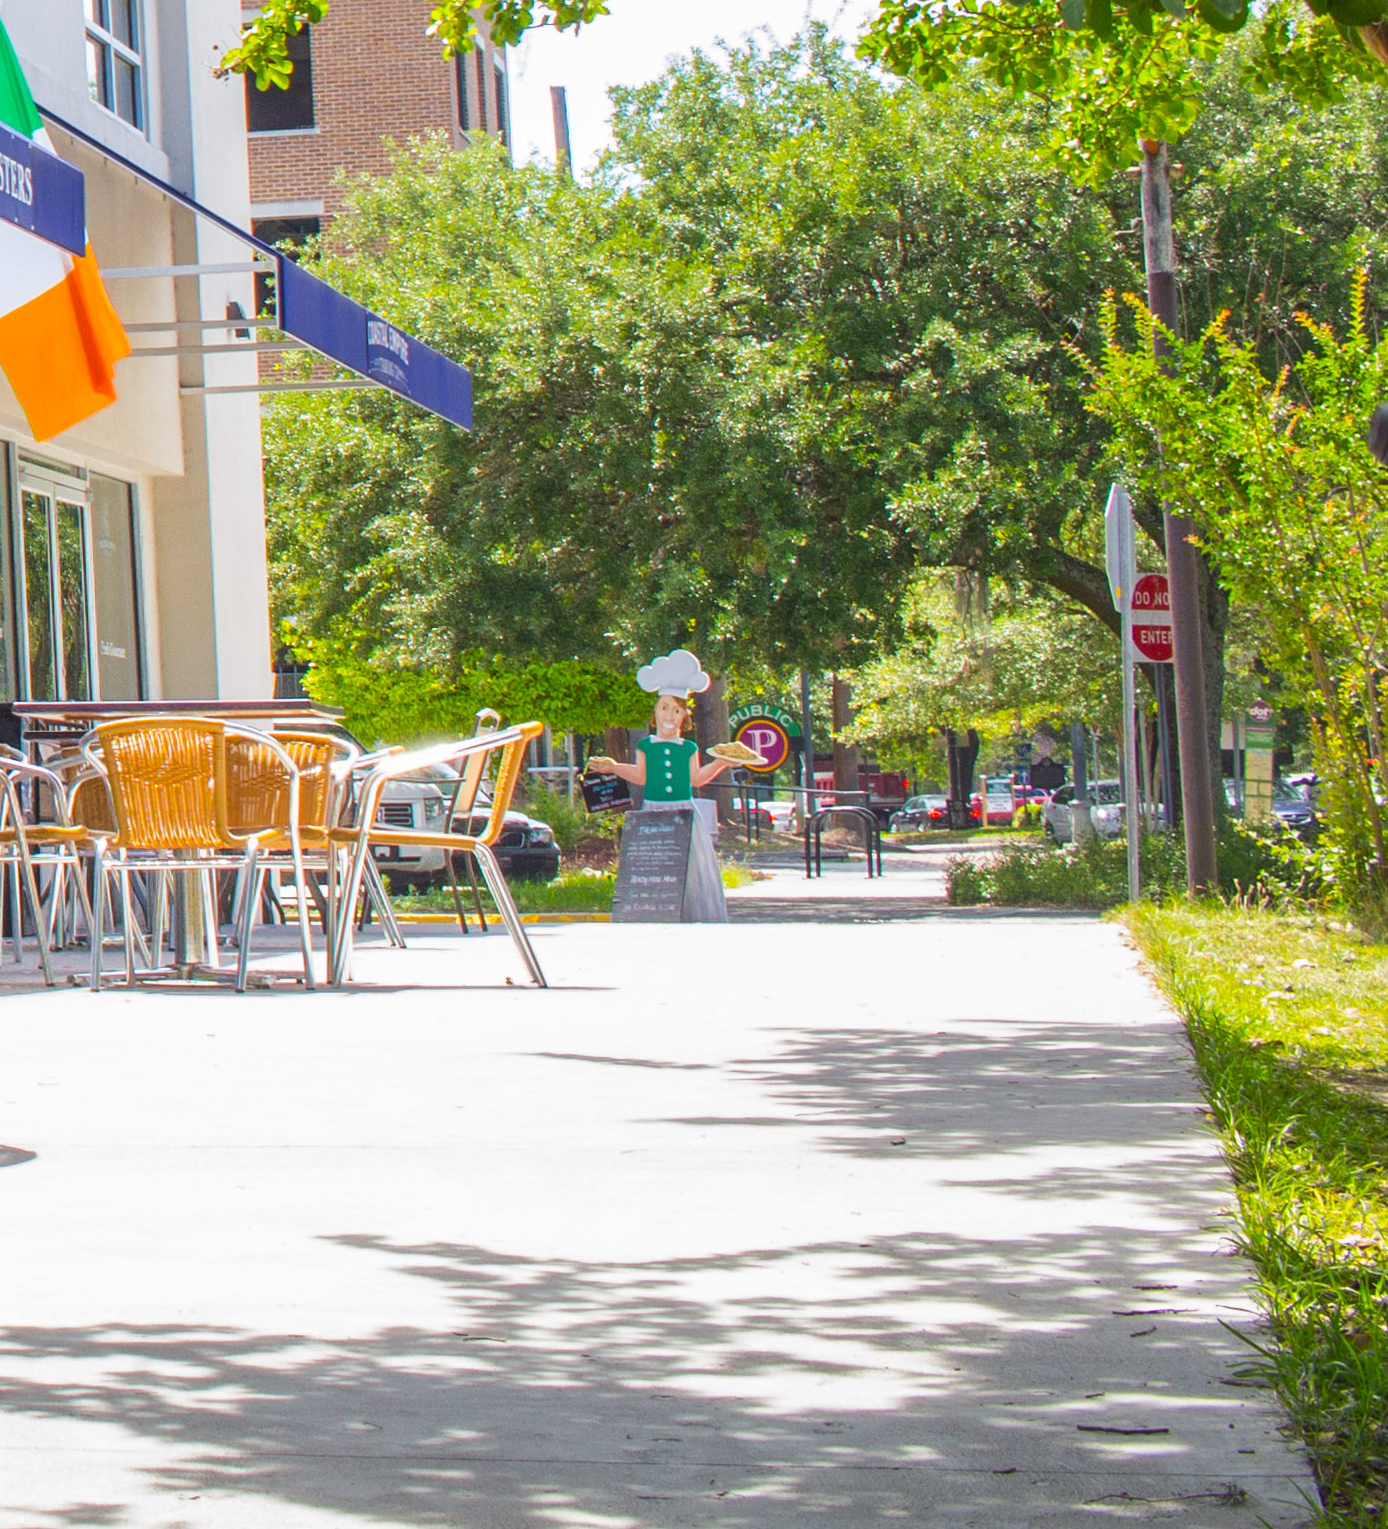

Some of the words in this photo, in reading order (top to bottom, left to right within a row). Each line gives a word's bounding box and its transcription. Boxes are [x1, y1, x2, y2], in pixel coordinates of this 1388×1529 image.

[1134, 592, 1150, 605] DO
[1155, 592, 1169, 605] NO
[728, 704, 793, 728] PUBLIC
[1249, 704, 1270, 718] dot
[747, 729, 778, 758] P
